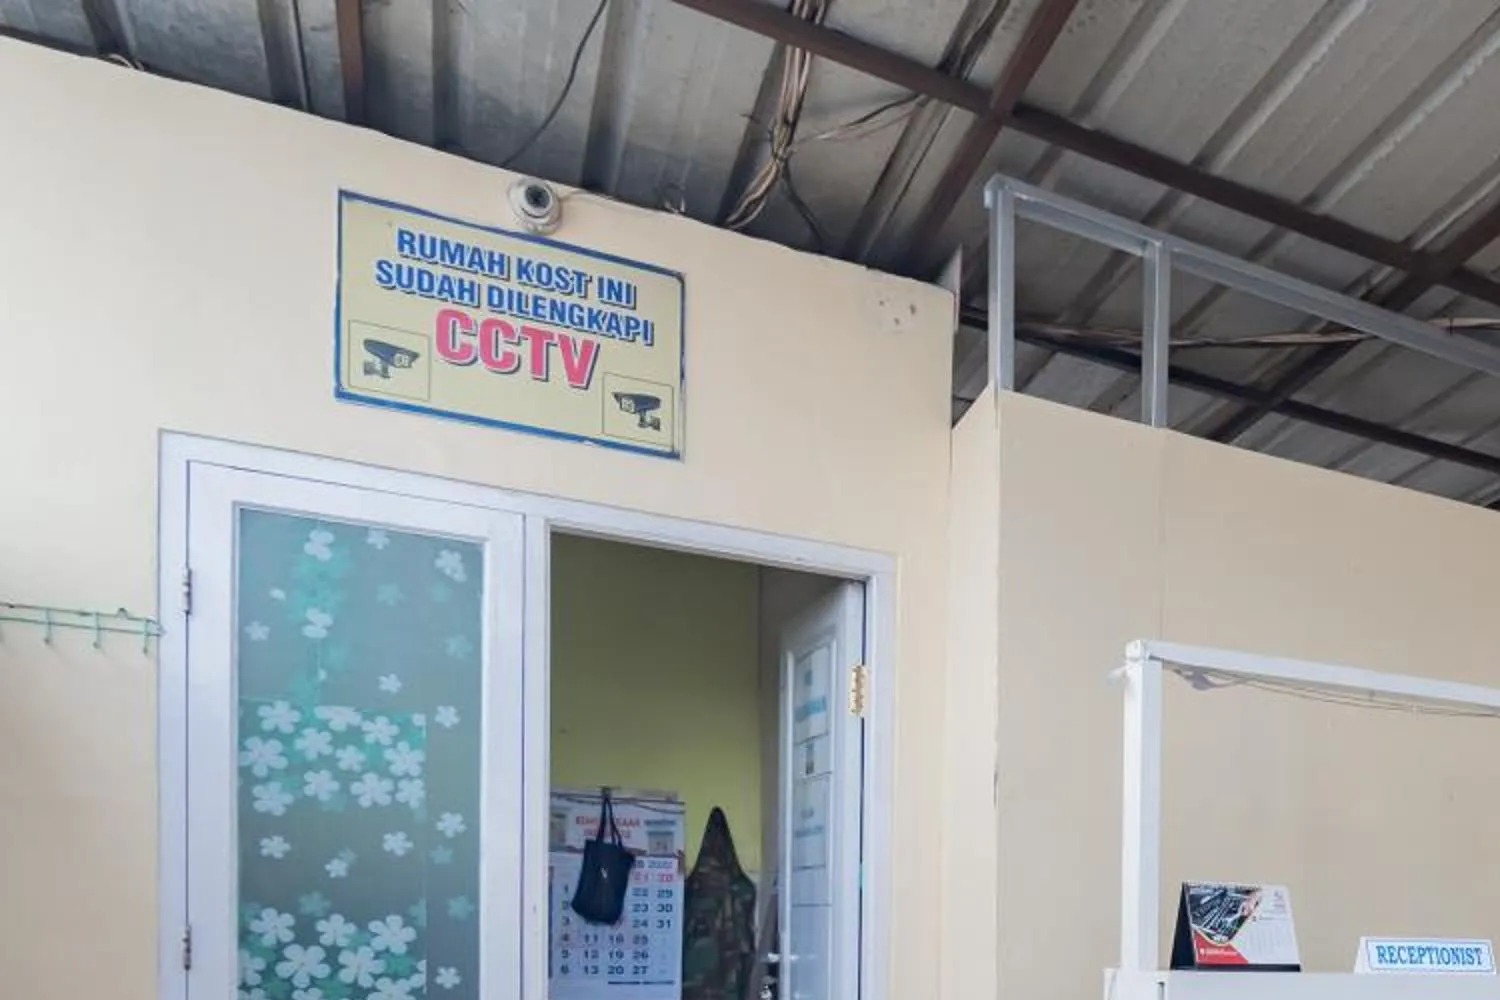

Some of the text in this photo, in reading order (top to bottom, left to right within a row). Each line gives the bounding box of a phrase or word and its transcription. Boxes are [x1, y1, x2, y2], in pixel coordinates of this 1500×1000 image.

[397, 227, 637, 309] RUMAH KOST INI
[375, 259, 655, 346] SUDAH DILENGKAPI
[434, 308, 599, 390] CCTV
[632, 903, 649, 912] 23
[656, 903, 673, 912] 30
[632, 919, 649, 928] 24
[656, 919, 671, 928] 31
[1376, 945, 1482, 965] RECEPTIONIST
[584, 965, 599, 975] 13
[608, 965, 624, 975] 20
[632, 965, 649, 975] 27
